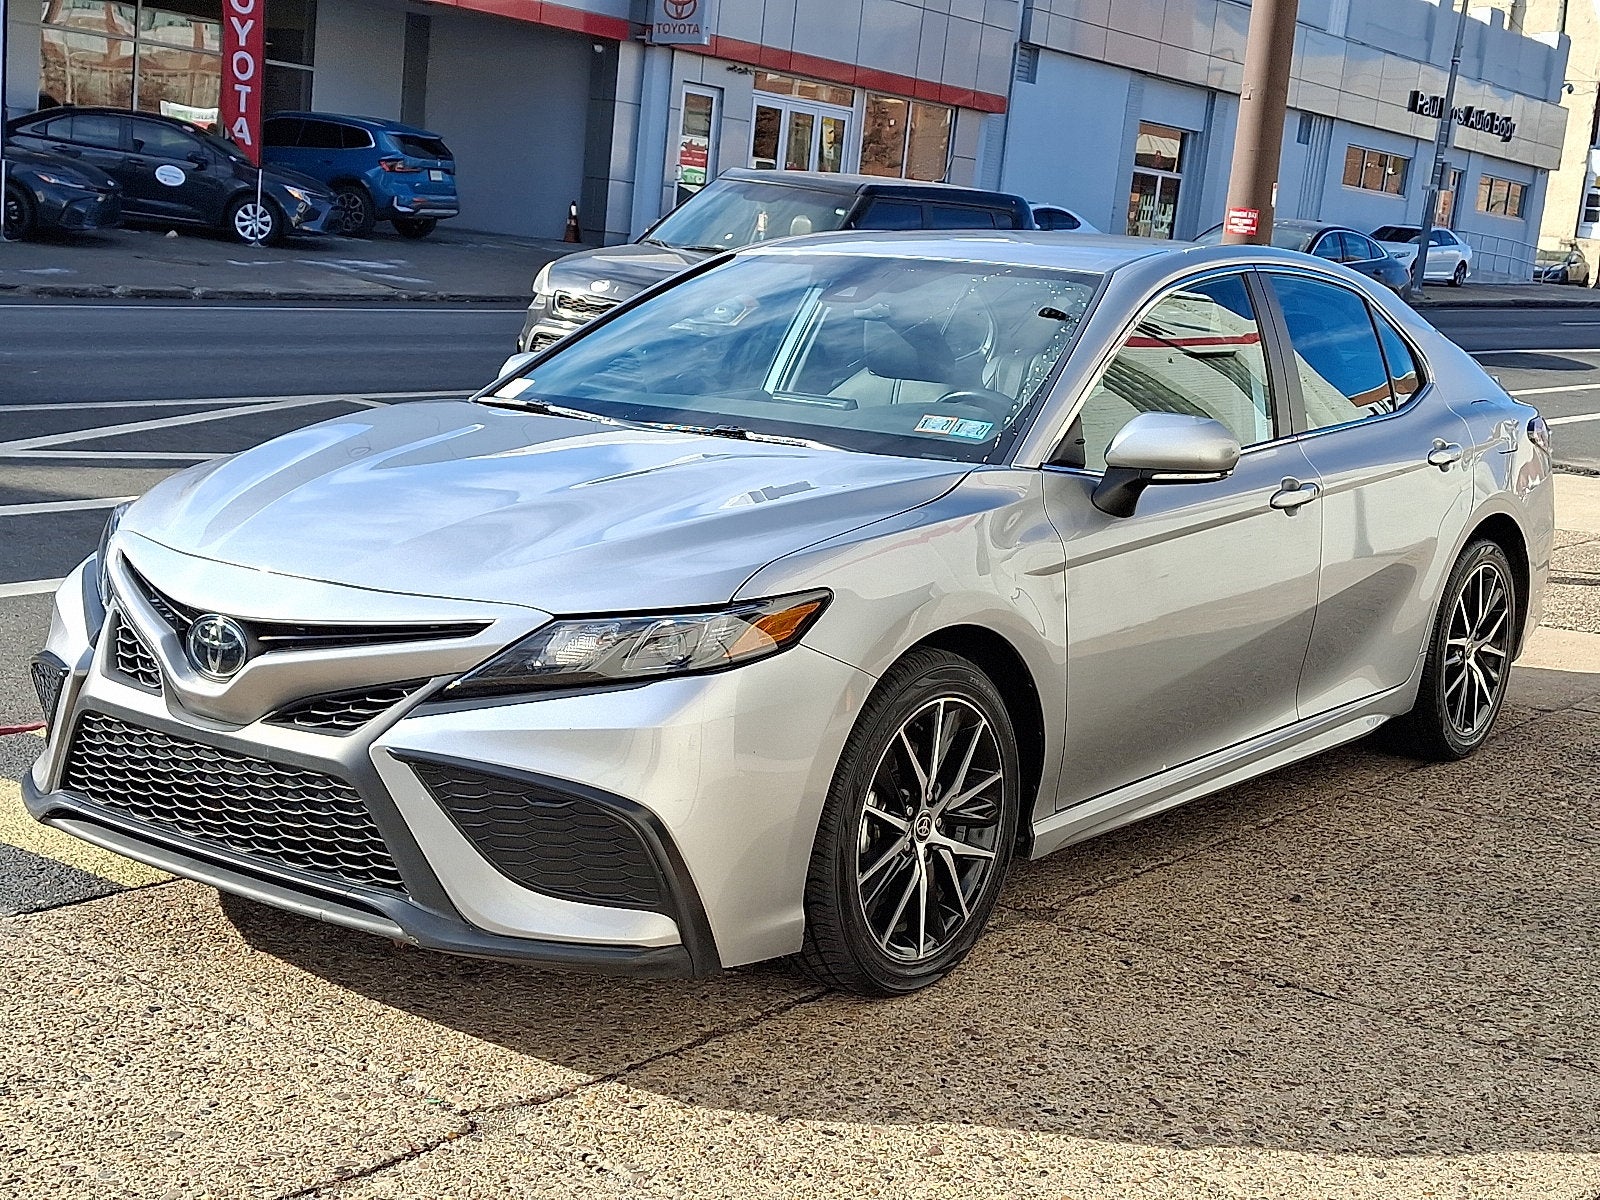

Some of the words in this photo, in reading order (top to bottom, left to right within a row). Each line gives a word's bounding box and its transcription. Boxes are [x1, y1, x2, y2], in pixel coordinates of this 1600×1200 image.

[656, 22, 700, 34] TOYOTA
[1411, 90, 1443, 118] Paul
[1467, 105, 1492, 131] Auto
